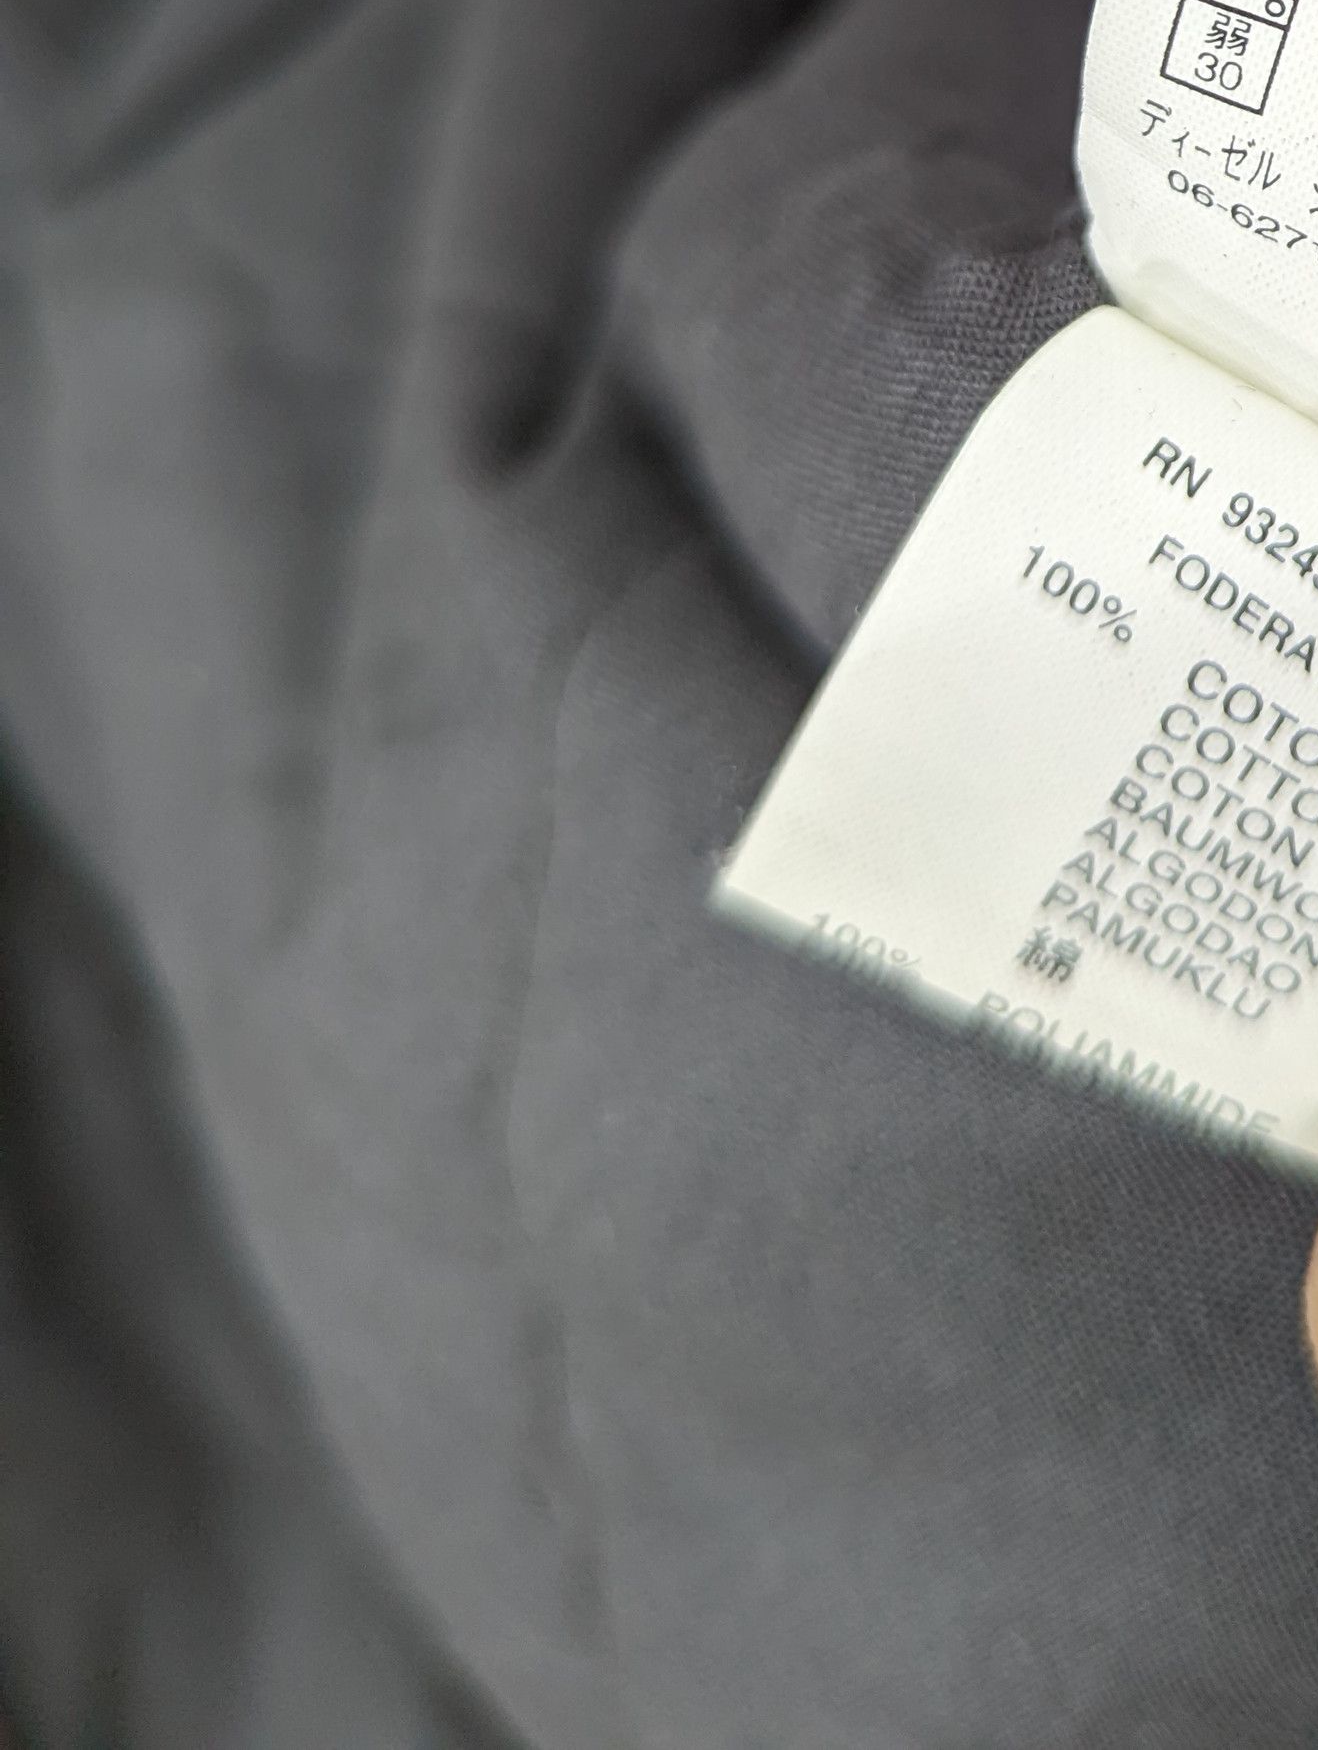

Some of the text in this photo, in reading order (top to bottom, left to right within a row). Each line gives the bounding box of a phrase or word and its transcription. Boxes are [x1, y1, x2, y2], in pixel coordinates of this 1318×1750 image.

[1194, 52, 1244, 91] 30
[1203, 11, 1253, 57] 弱
[1142, 436, 1213, 499] RN
[1018, 544, 1138, 644] 100%
[1148, 534, 1318, 674] FODERA
[1134, 742, 1317, 869] COTON
[1040, 881, 1272, 1021] PAMUKLU
[1061, 849, 1302, 996] ALGODAO
